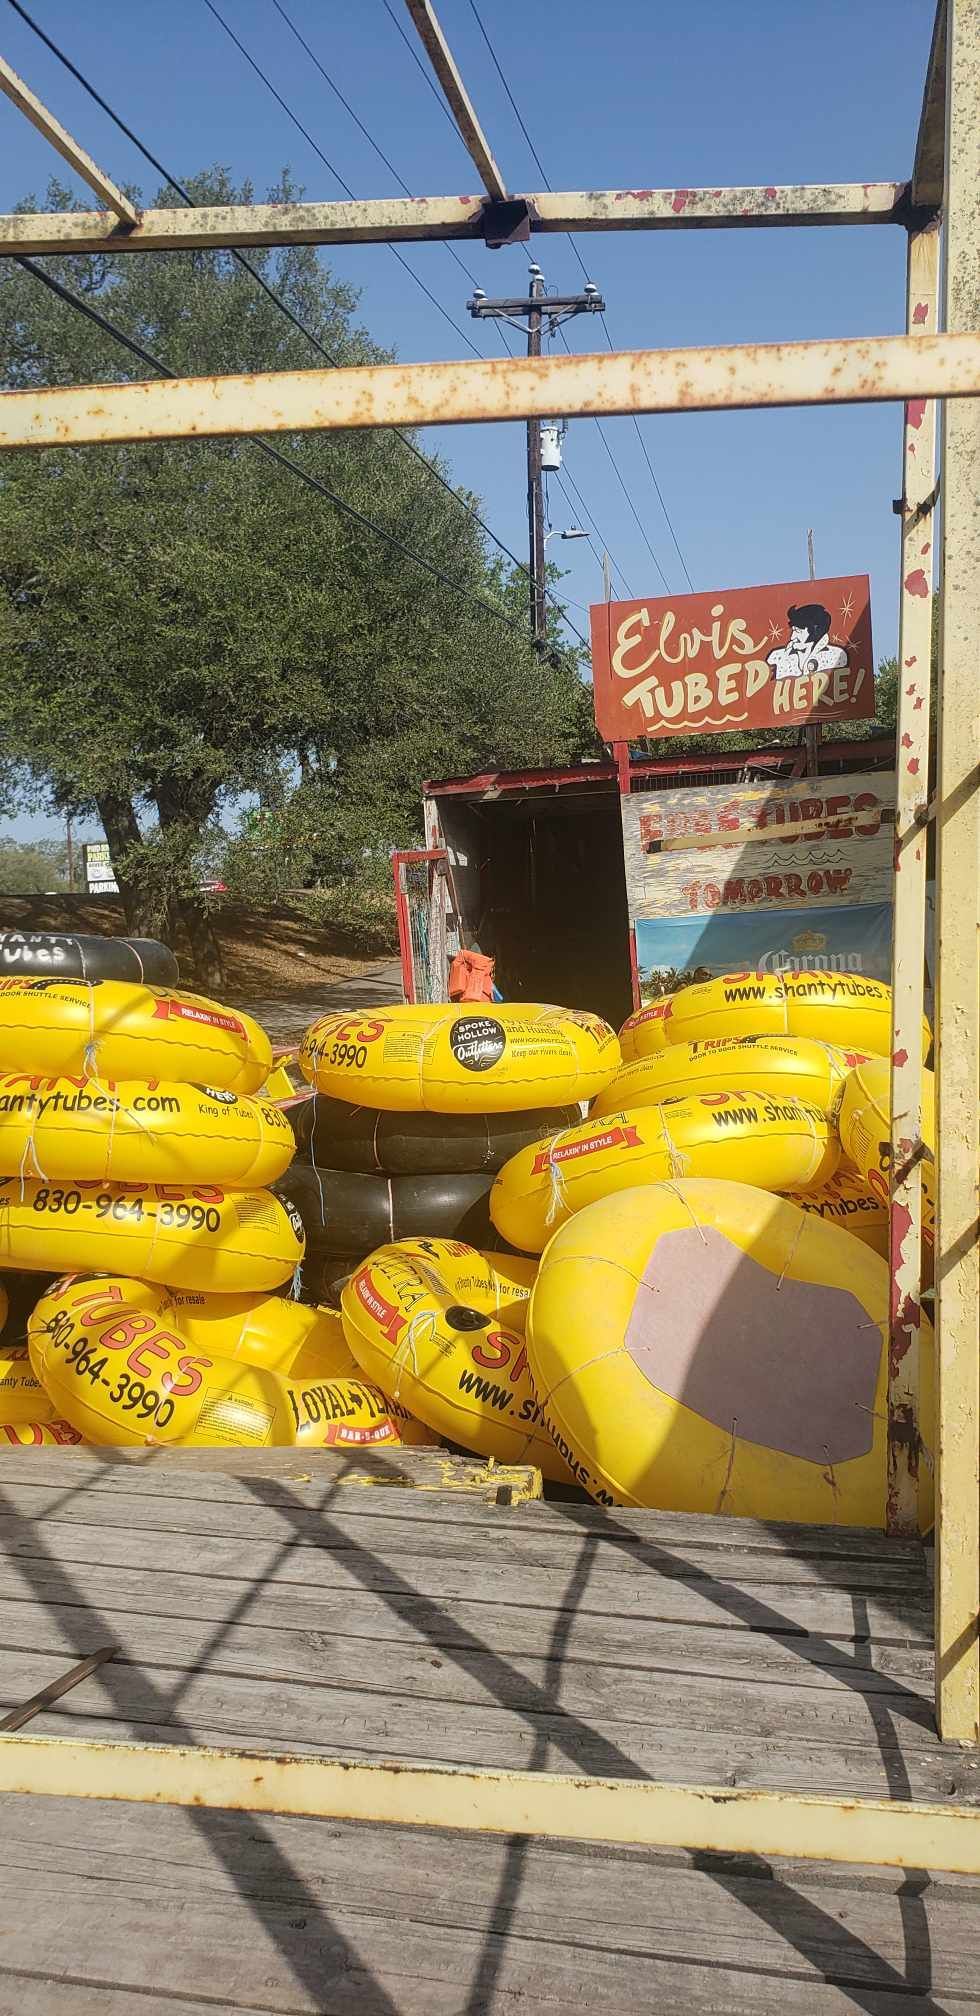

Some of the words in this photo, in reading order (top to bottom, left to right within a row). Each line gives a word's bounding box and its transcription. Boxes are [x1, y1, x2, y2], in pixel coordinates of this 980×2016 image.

[612, 604, 768, 678] Elvis
[621, 660, 770, 717] TUBED
[772, 668, 866, 715] HERE!
[680, 868, 854, 911] TOMORROW
[757, 949, 865, 975] Corona
[457, 1027, 497, 1042] HOLLOW
[458, 1021, 491, 1033] SPOKE
[199, 1104, 219, 1118] King
[221, 1106, 231, 1117] of
[581, 1143, 589, 1153] IN
[589, 1136, 613, 1150] STYLE
[33, 1189, 221, 1233] 830-964-3990
[72, 1286, 214, 1396] TUBES
[287, 1383, 356, 1433] LOYAL
